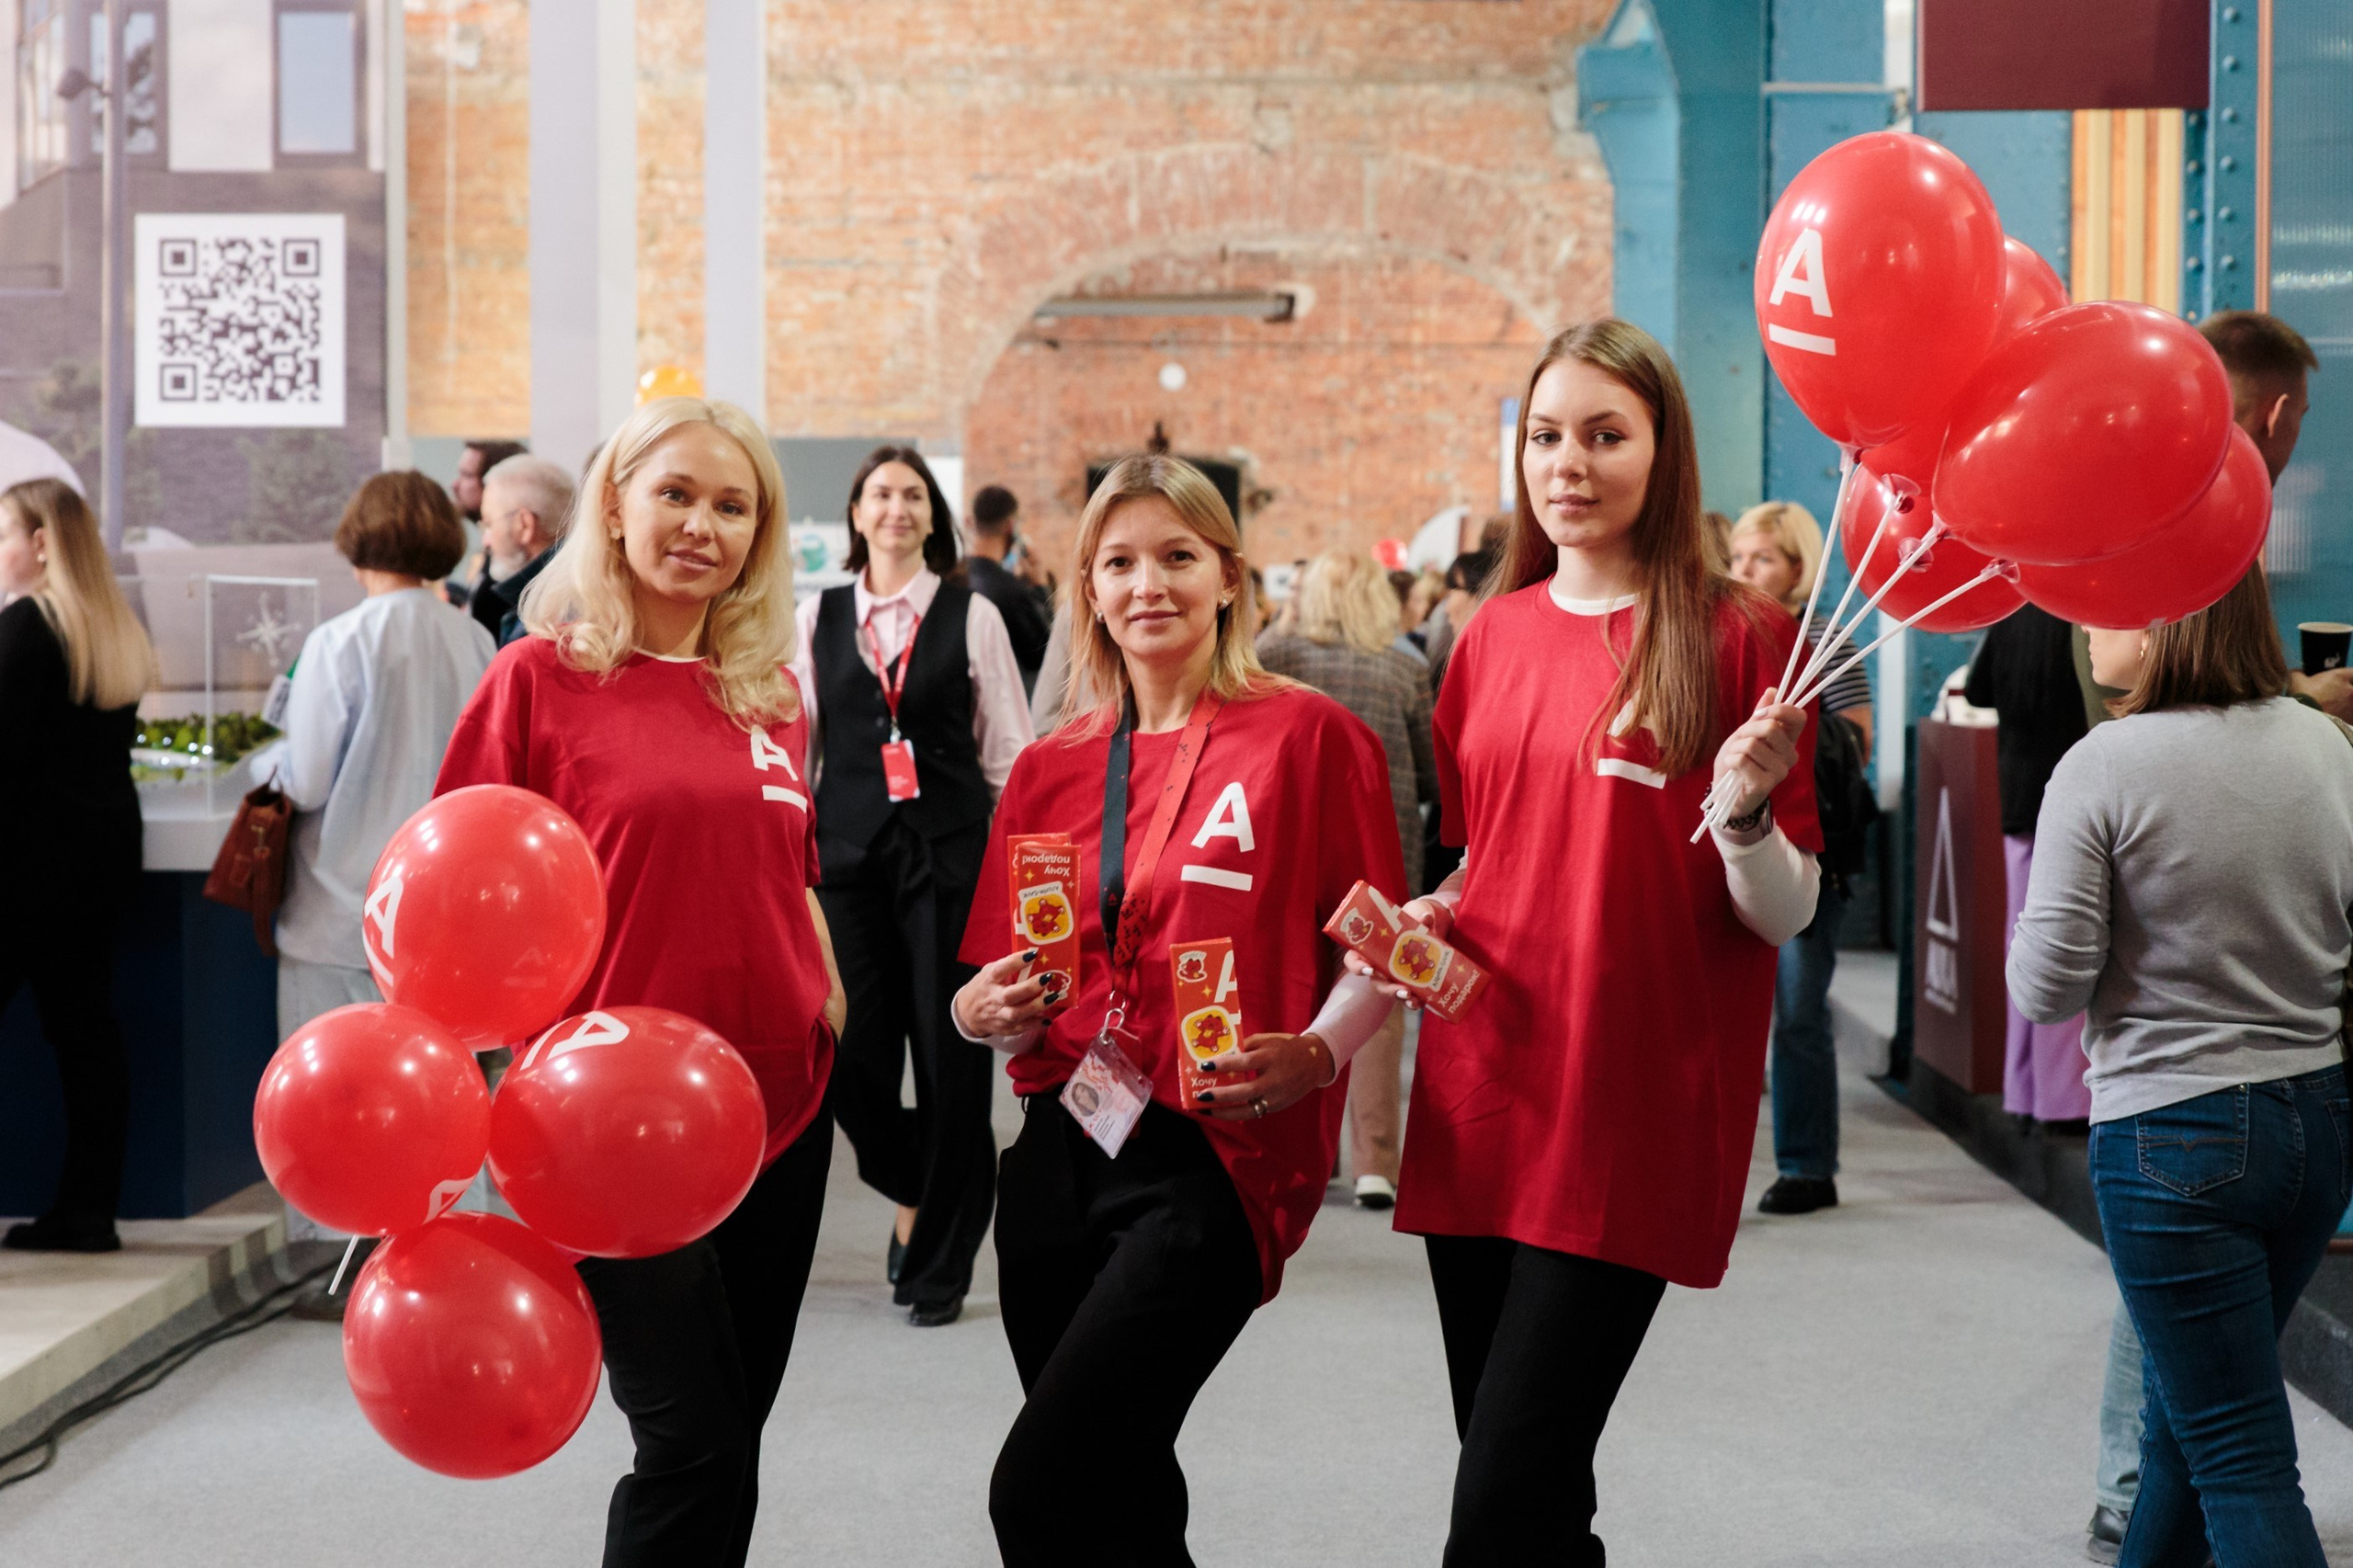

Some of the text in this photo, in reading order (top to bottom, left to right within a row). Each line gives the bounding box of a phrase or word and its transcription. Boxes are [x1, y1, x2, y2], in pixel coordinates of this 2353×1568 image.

[1769, 228, 1833, 318] А
[1190, 781, 1256, 853] А
[1021, 854, 1071, 865] подарок!
[1044, 865, 1071, 877] Хочу
[1438, 982, 1460, 1007] Хочу
[1448, 969, 1482, 1014] подарок!
[1190, 1077, 1218, 1087] Хочу
